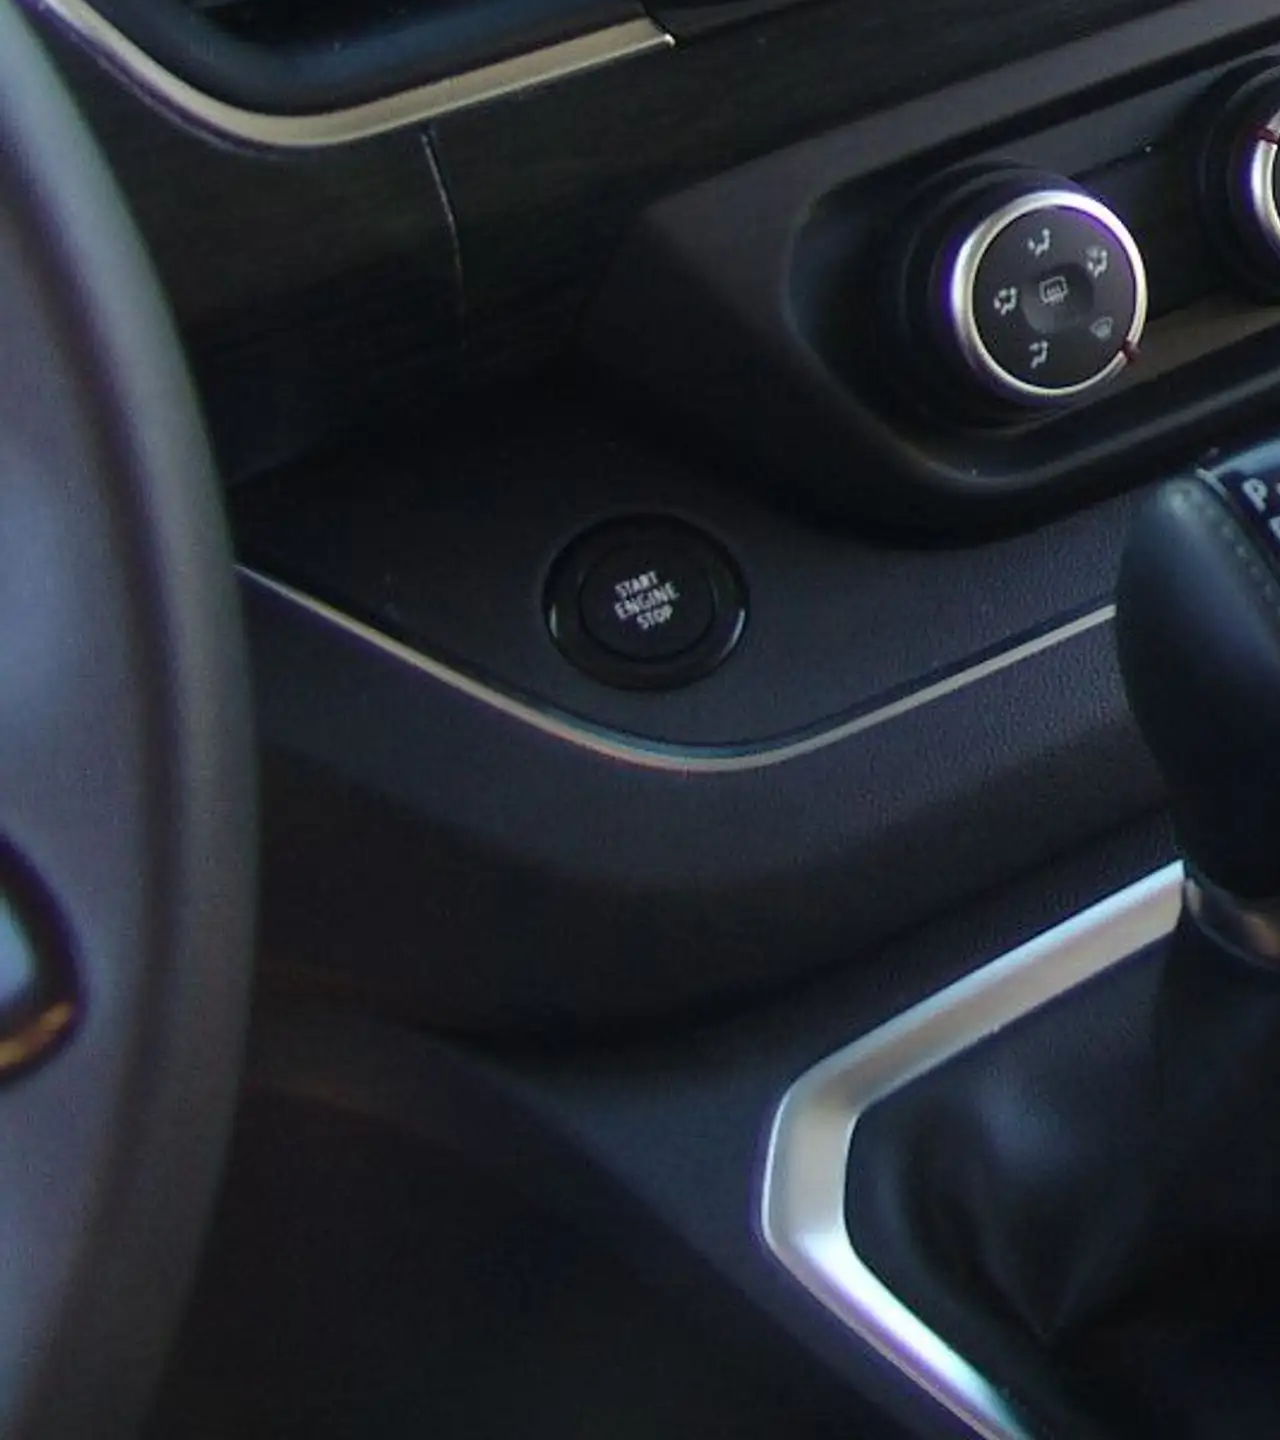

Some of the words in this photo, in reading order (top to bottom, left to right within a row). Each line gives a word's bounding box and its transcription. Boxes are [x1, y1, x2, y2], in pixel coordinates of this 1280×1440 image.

[1241, 476, 1269, 512] P
[613, 570, 659, 600] START
[613, 581, 681, 620] ENGINE
[635, 604, 674, 631] STOP
